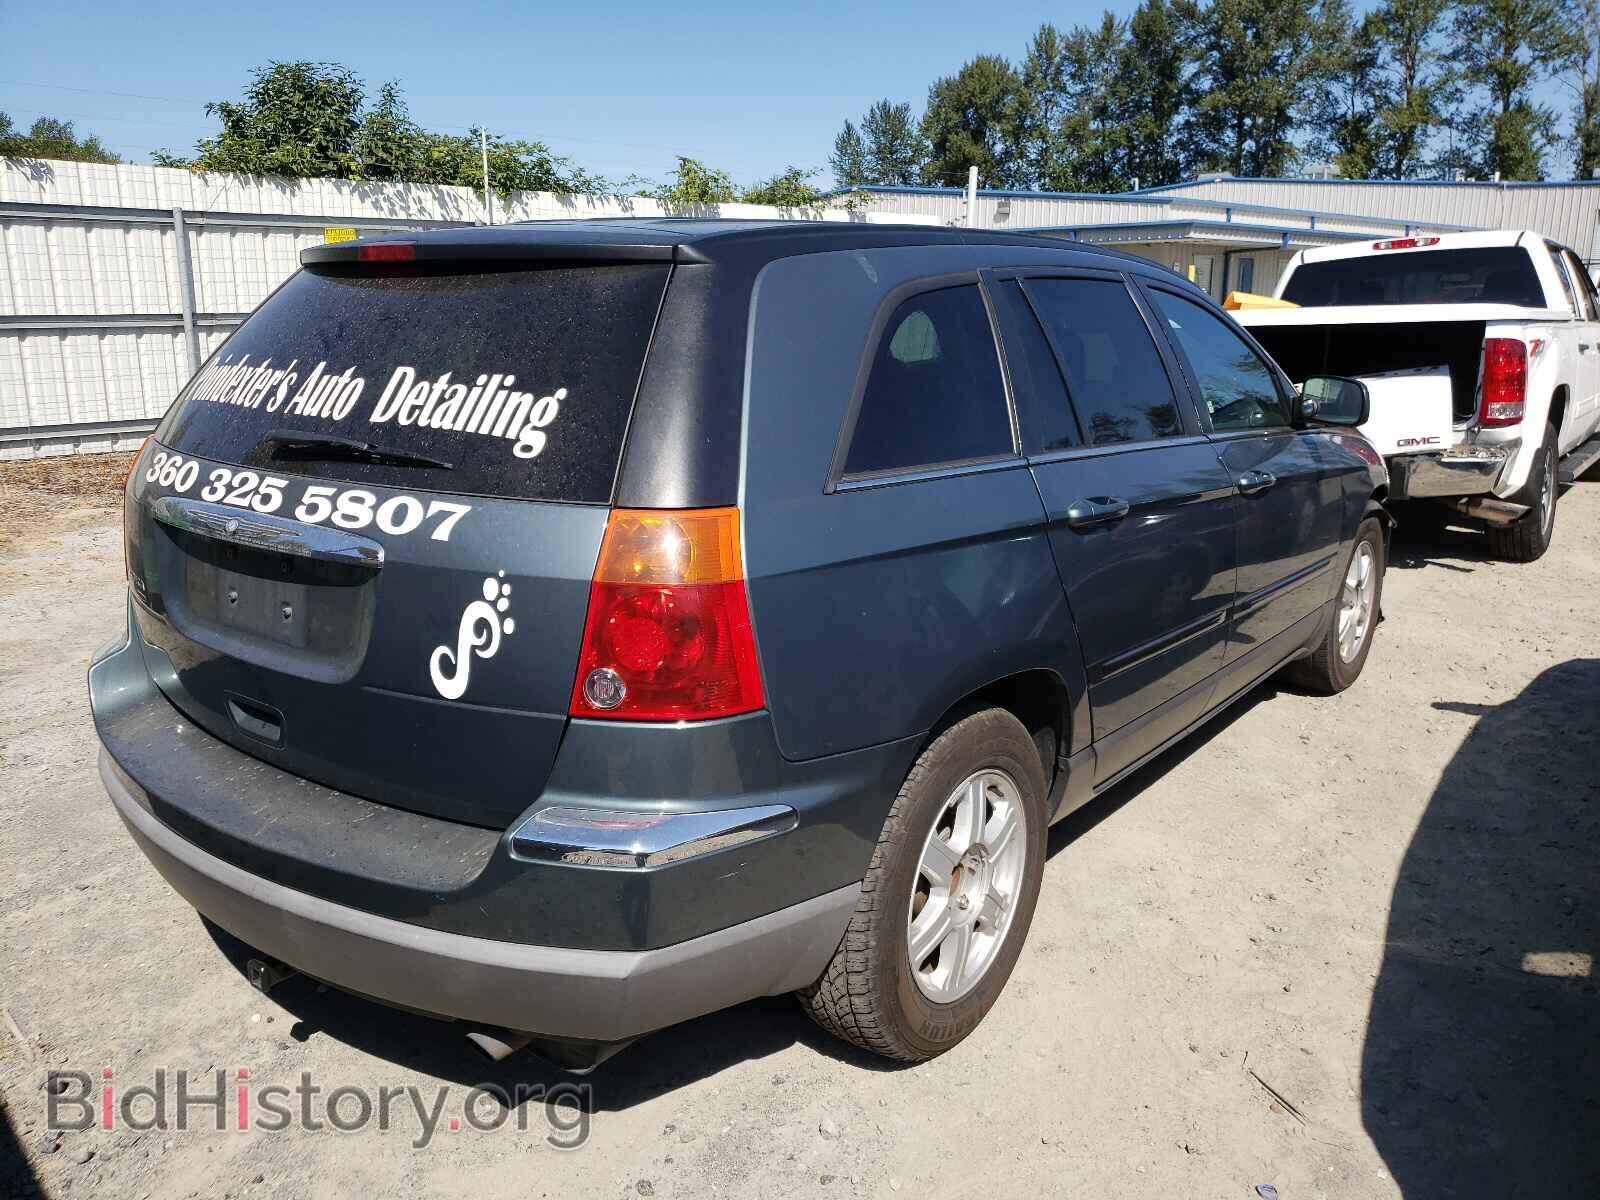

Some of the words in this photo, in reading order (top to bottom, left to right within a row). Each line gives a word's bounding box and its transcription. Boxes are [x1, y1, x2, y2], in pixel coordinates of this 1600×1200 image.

[284, 361, 365, 421] Auto
[369, 366, 568, 459] Detailing
[1396, 436, 1441, 447] GMC
[146, 452, 200, 493] 360
[201, 468, 289, 513] 325
[295, 485, 472, 542] 5807
